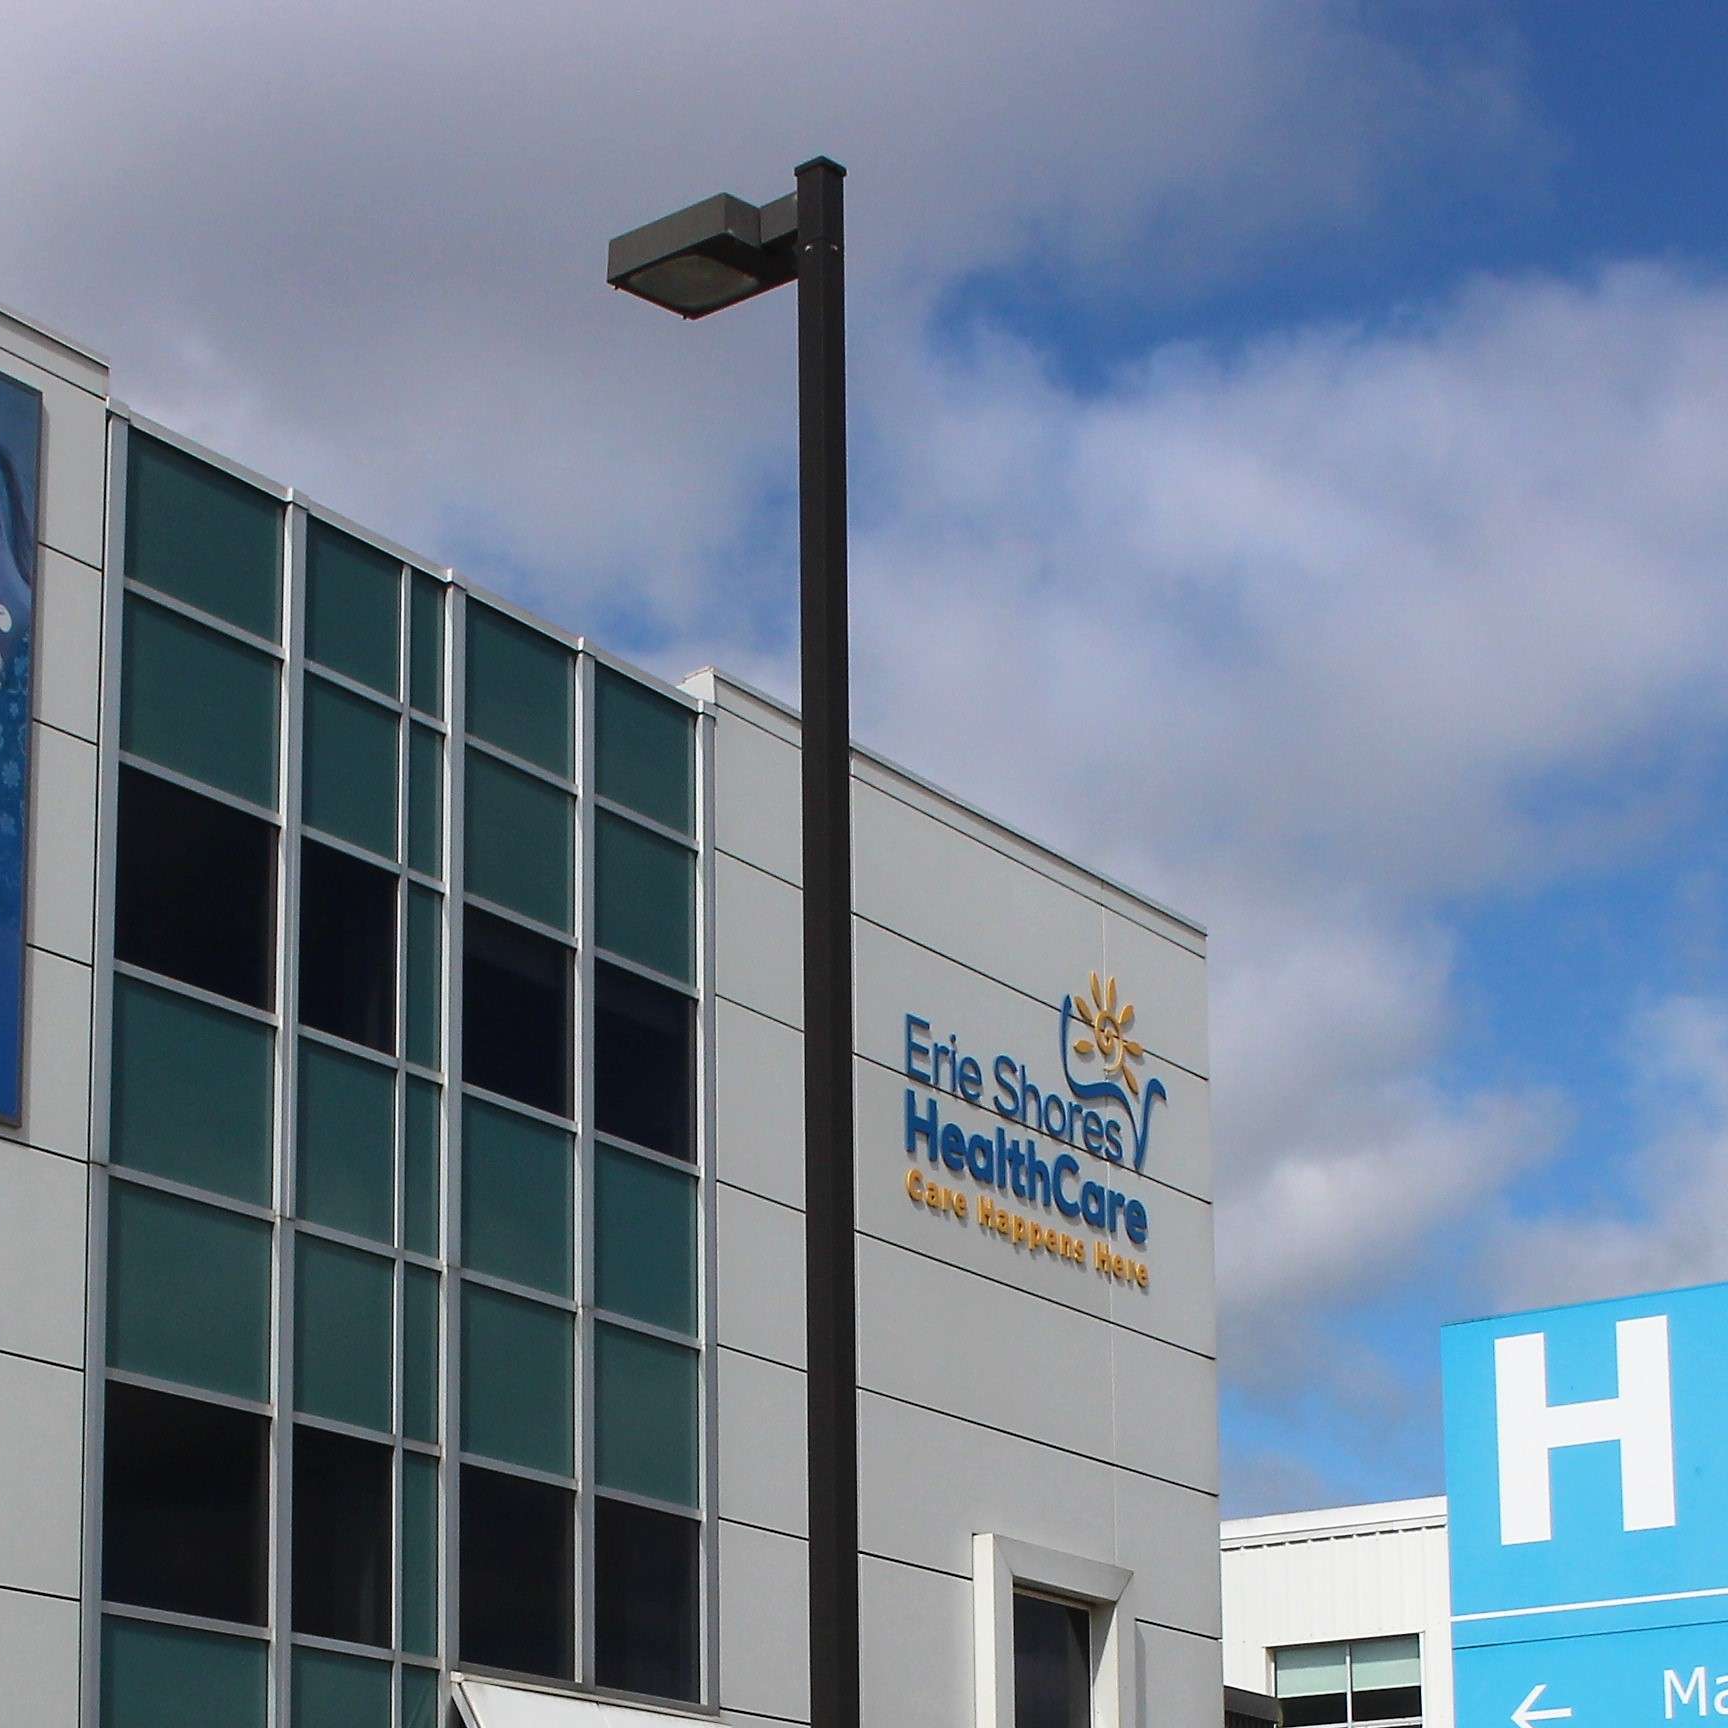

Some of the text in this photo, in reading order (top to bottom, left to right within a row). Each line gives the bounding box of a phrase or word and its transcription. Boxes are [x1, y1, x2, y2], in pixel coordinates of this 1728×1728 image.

[904, 1012, 1123, 1162] Erie Shores
[904, 1088, 1149, 1245] HealthCare
[904, 1168, 1150, 1289] Care Happens Here
[1494, 1314, 1677, 1546] H
